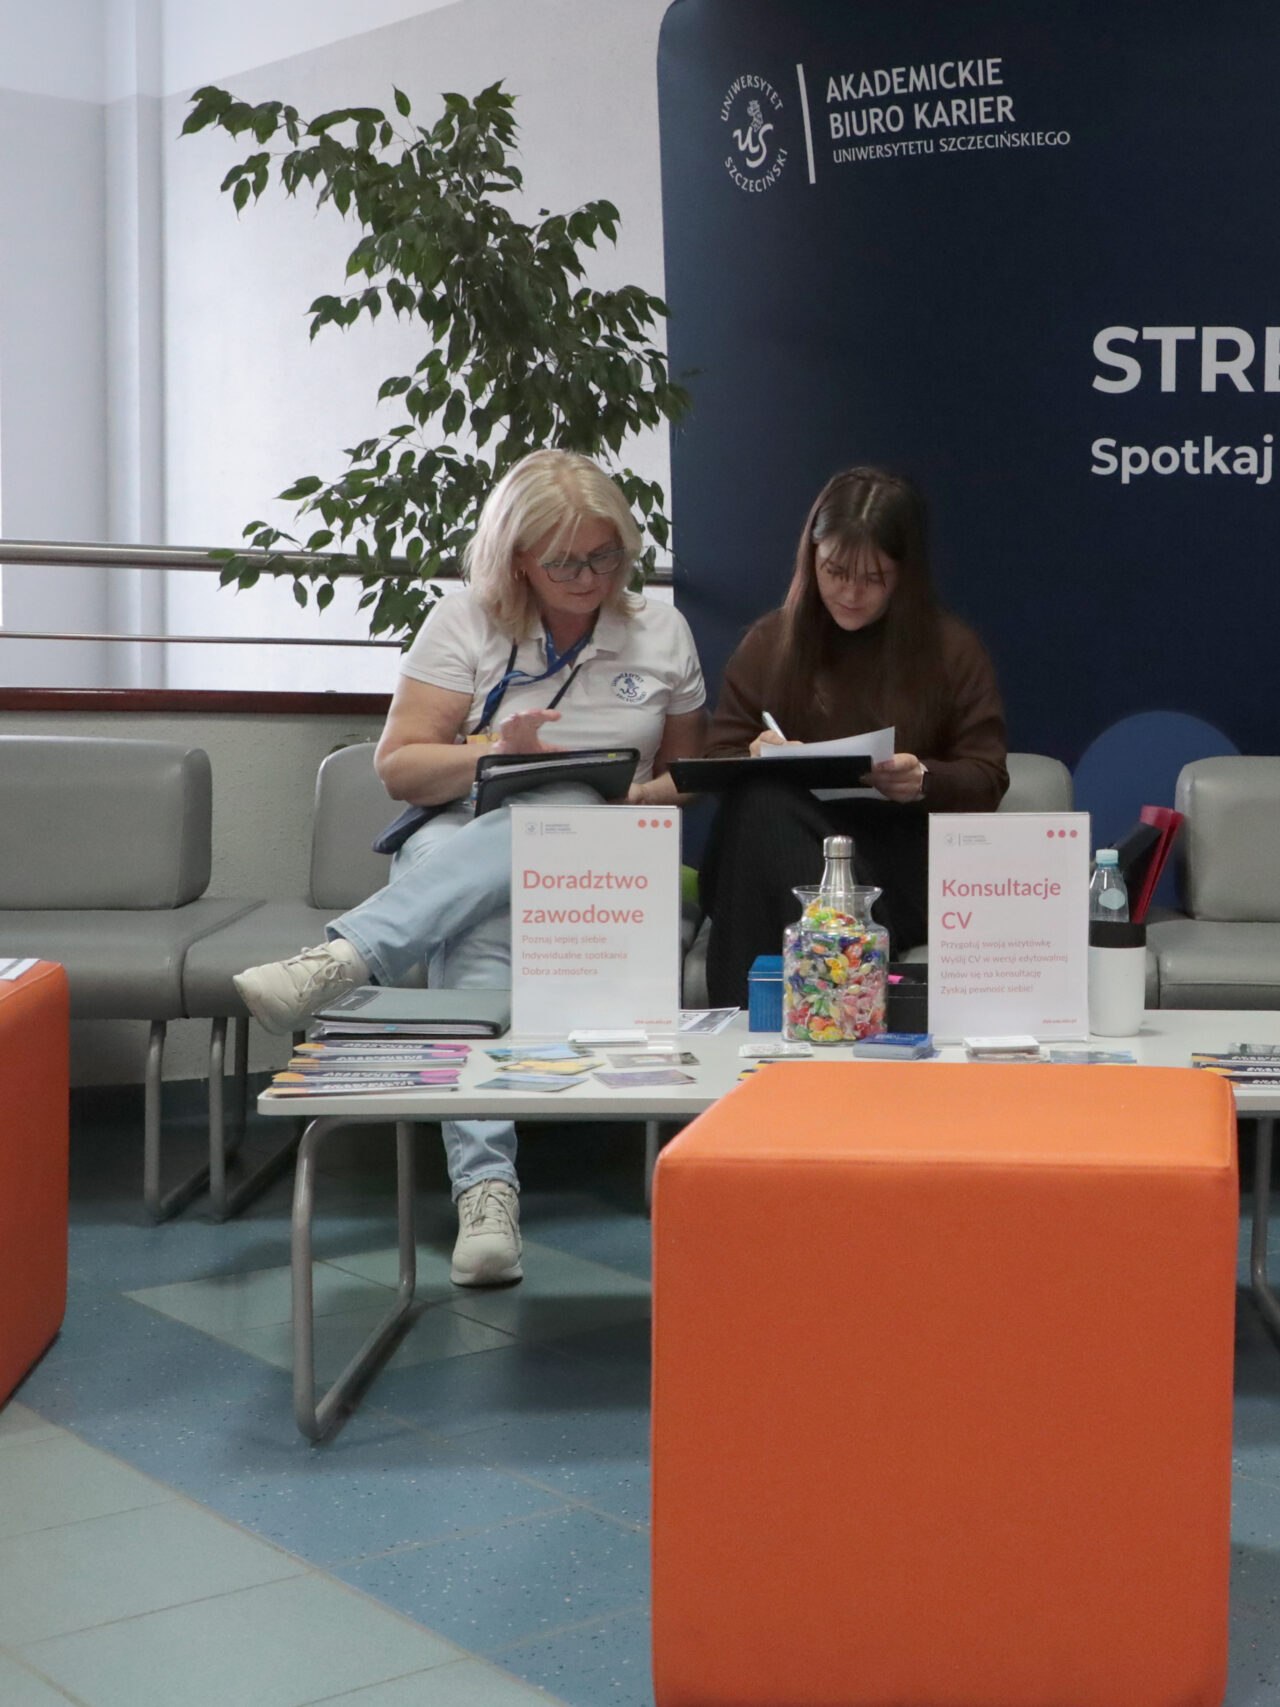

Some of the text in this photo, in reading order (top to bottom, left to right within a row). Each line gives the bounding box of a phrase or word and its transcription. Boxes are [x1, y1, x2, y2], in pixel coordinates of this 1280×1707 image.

[826, 58, 1003, 103] AKADEMICKIE
[721, 74, 783, 122] UNIWERSYTET
[829, 96, 1016, 139] BIURO KARIER
[832, 130, 1071, 164] UNIWERSYTETU SZCZECIŃSKIEGO
[725, 148, 787, 192] SZCZECIŃSKI
[1091, 434, 1274, 485] Spotkaj
[522, 870, 648, 890] Doradztwo
[942, 878, 1061, 900] Konsultacje
[522, 904, 644, 924] zawodowe
[941, 911, 972, 930] CV
[522, 934, 607, 945] Poznaj lepiej siebie
[522, 951, 628, 961] Indywidualne spotkania
[968, 955, 981, 963] CV
[522, 967, 598, 976] Dobra atmosfera
[940, 985, 967, 995] Zyskaj
